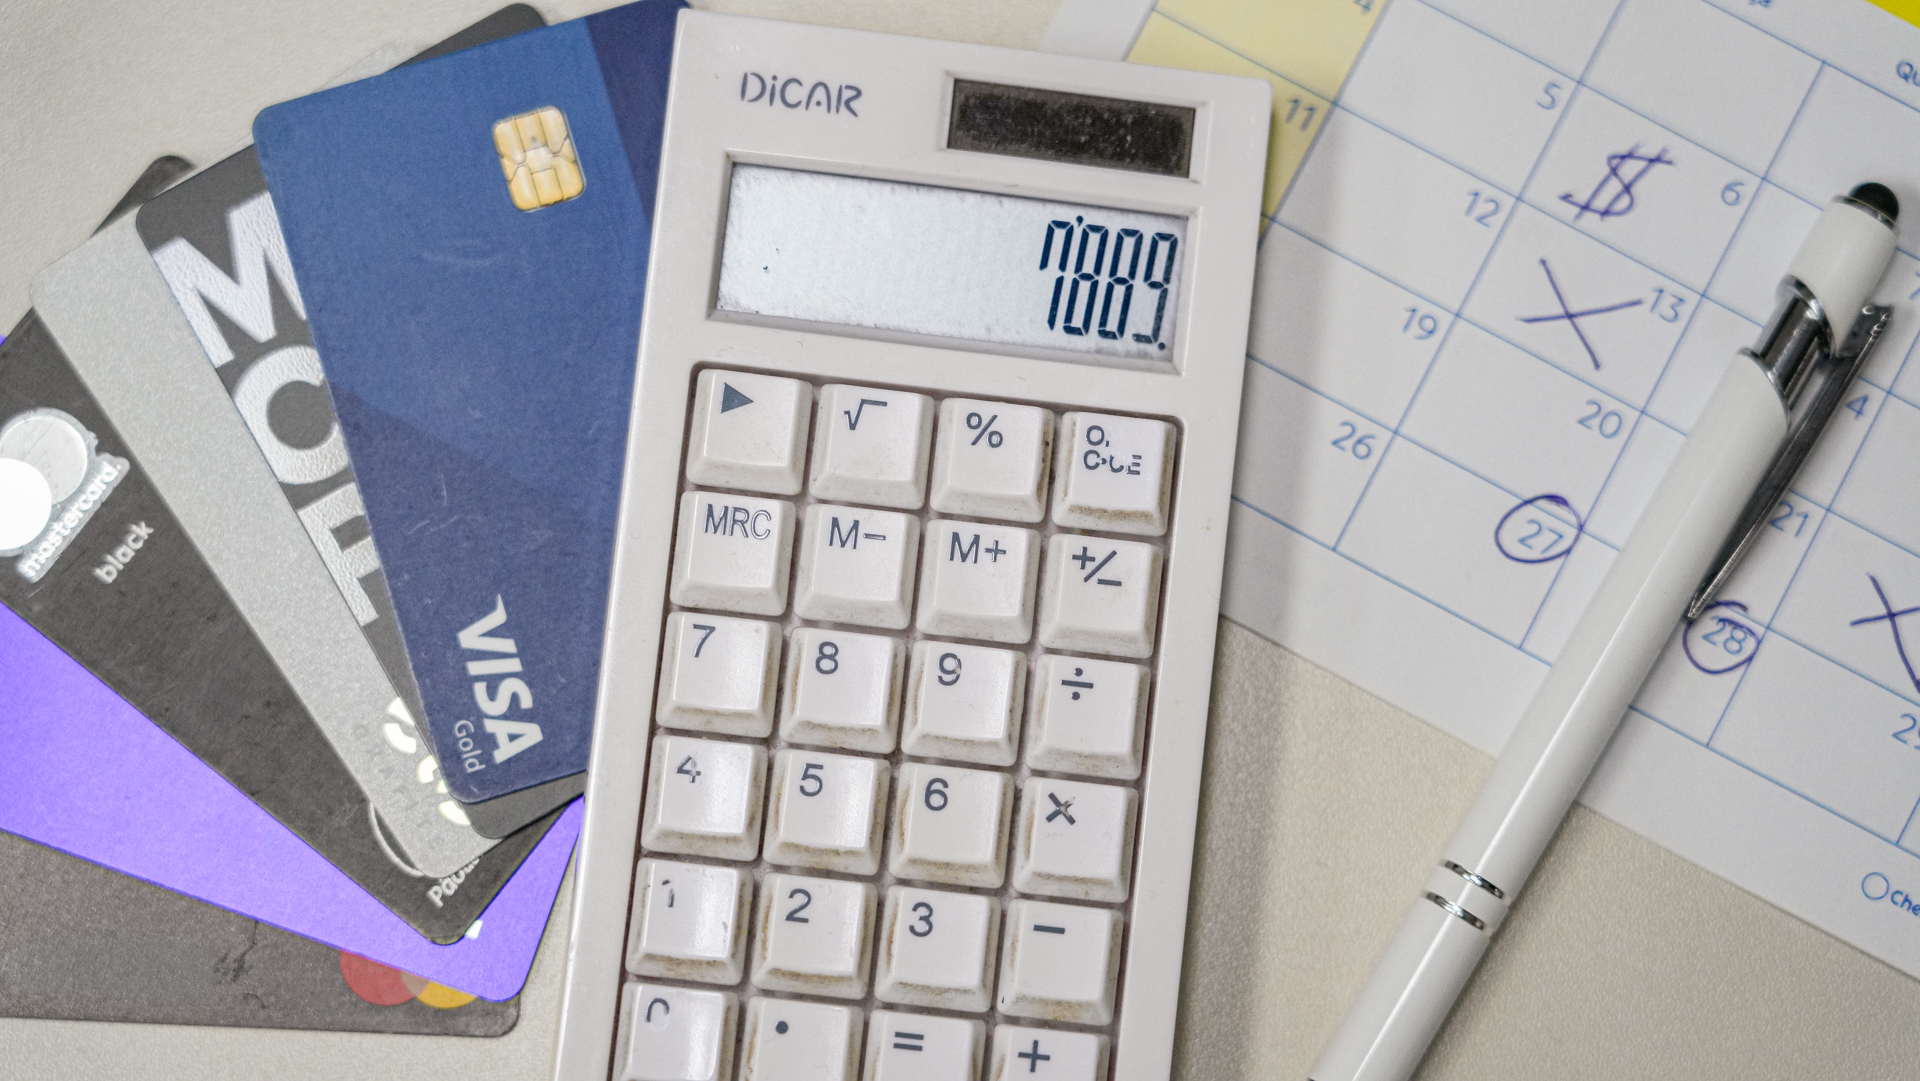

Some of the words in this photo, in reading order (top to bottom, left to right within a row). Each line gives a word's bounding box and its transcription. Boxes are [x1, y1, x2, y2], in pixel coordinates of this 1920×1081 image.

[740, 72, 863, 118] DiCAR
[1537, 81, 1562, 110] 5
[1284, 97, 1317, 132] 11
[1465, 188, 1501, 229] 12
[1721, 181, 1744, 206] 6
[1650, 287, 1683, 324] 13
[1401, 306, 1439, 342] 19
[1577, 400, 1623, 440] 20
[1846, 395, 1870, 420] 4
[1331, 421, 1374, 461] 26
[704, 503, 773, 541] MRC
[1516, 519, 1564, 556] 27
[1770, 501, 1809, 538] 21
[93, 520, 154, 584] black
[949, 531, 1007, 565] M+
[692, 624, 716, 659] 7
[1702, 615, 1748, 655] 28
[815, 641, 840, 676] 8
[937, 652, 962, 687] 9
[458, 593, 544, 765] VISA
[455, 719, 487, 774] Gold
[676, 755, 702, 784] 4
[799, 762, 824, 798] 5
[924, 777, 950, 812] 6
[785, 888, 812, 924] 2
[908, 901, 934, 938] 3
